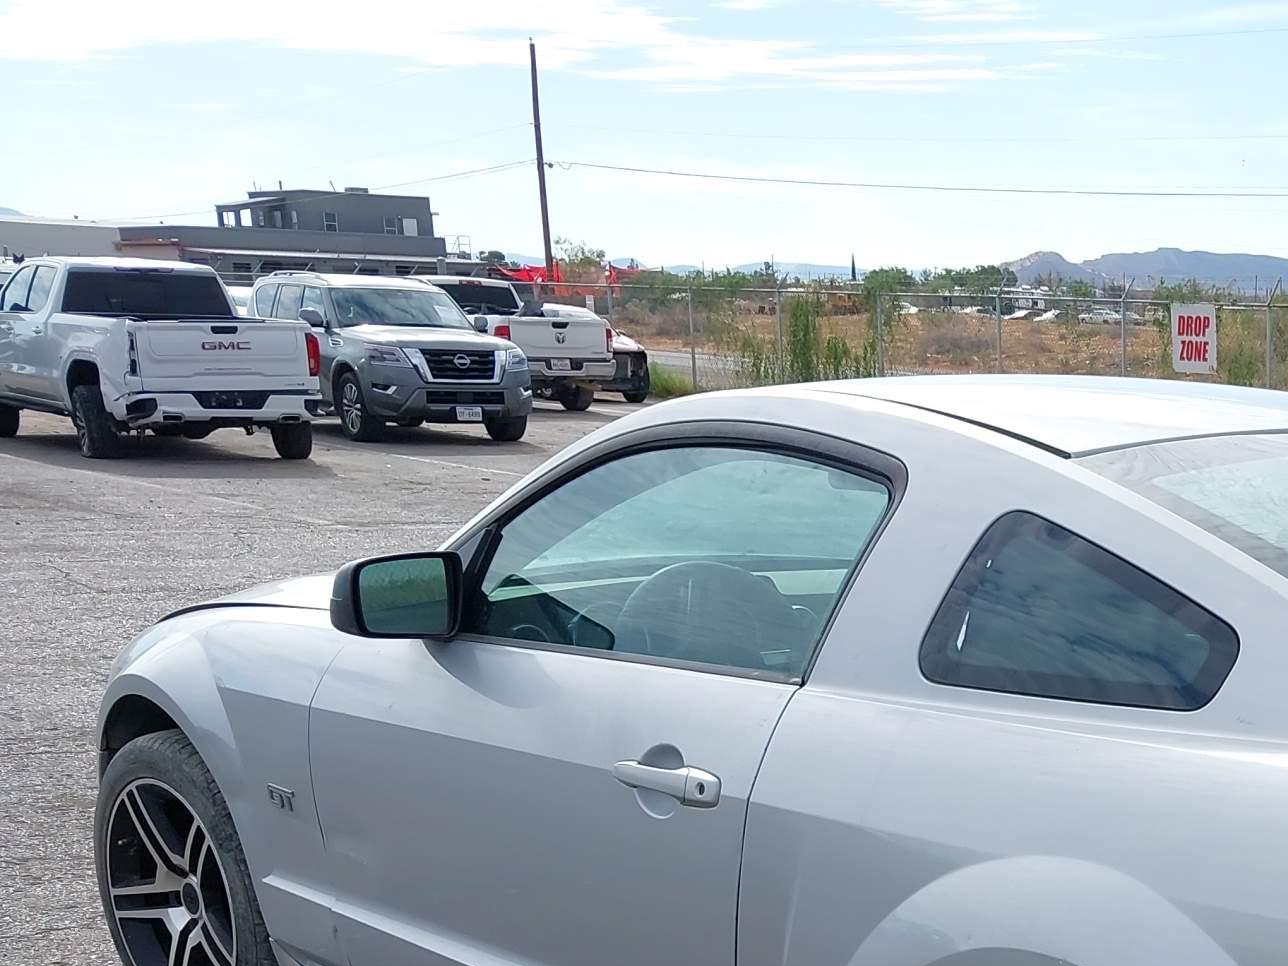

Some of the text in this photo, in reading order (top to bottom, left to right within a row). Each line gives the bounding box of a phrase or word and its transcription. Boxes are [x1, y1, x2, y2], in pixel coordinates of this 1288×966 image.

[1177, 315, 1210, 337] DROP
[201, 341, 252, 350] GMC
[1179, 340, 1209, 362] ZONE
[267, 782, 295, 812] GT
